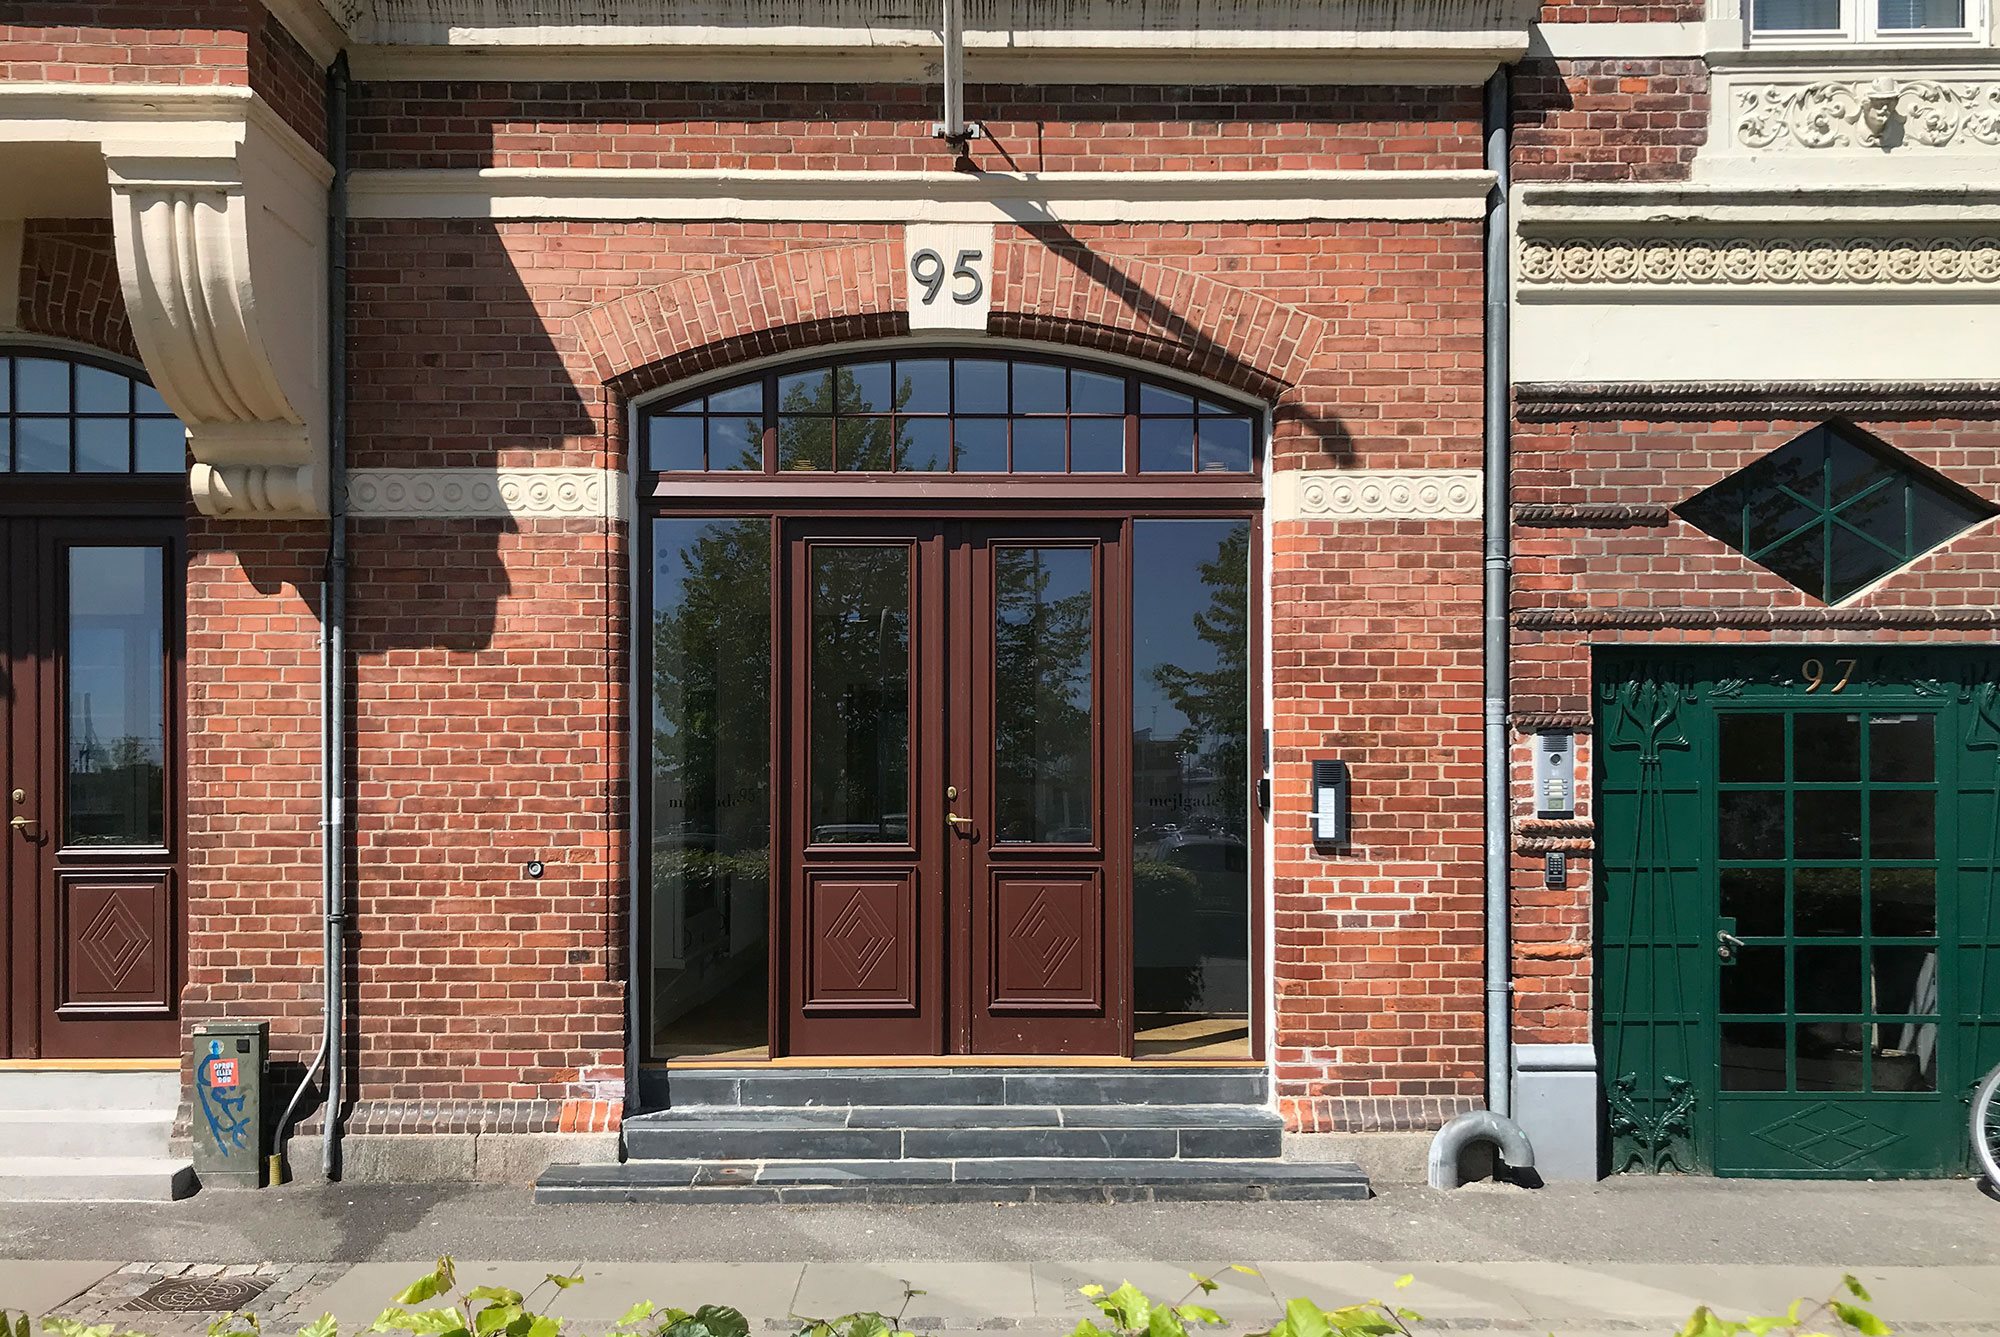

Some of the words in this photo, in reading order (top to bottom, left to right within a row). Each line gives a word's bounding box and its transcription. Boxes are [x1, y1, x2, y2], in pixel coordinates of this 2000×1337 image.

[910, 248, 984, 306] 95
[1801, 658, 1857, 693] 97
[1149, 793, 1221, 812] mejlgade
